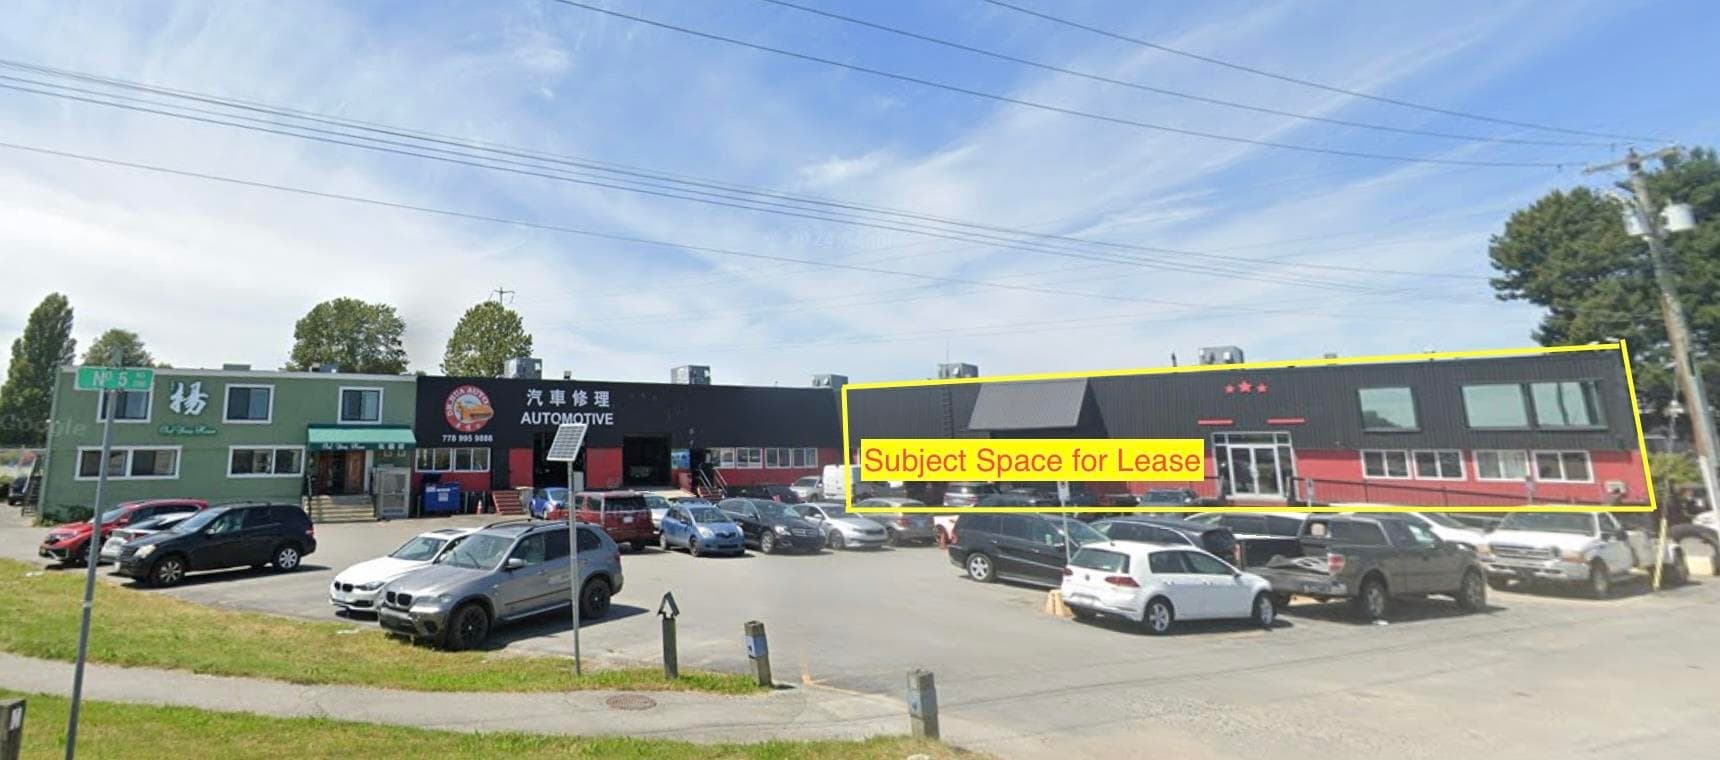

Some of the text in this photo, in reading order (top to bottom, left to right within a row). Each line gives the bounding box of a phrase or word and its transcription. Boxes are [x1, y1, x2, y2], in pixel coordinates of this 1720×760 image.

[118, 371, 129, 387] 5
[467, 387, 489, 404] AUTO
[527, 388, 610, 408] 汽車修理
[520, 412, 614, 426] AUTOMOTIVE
[442, 434, 456, 442] 778
